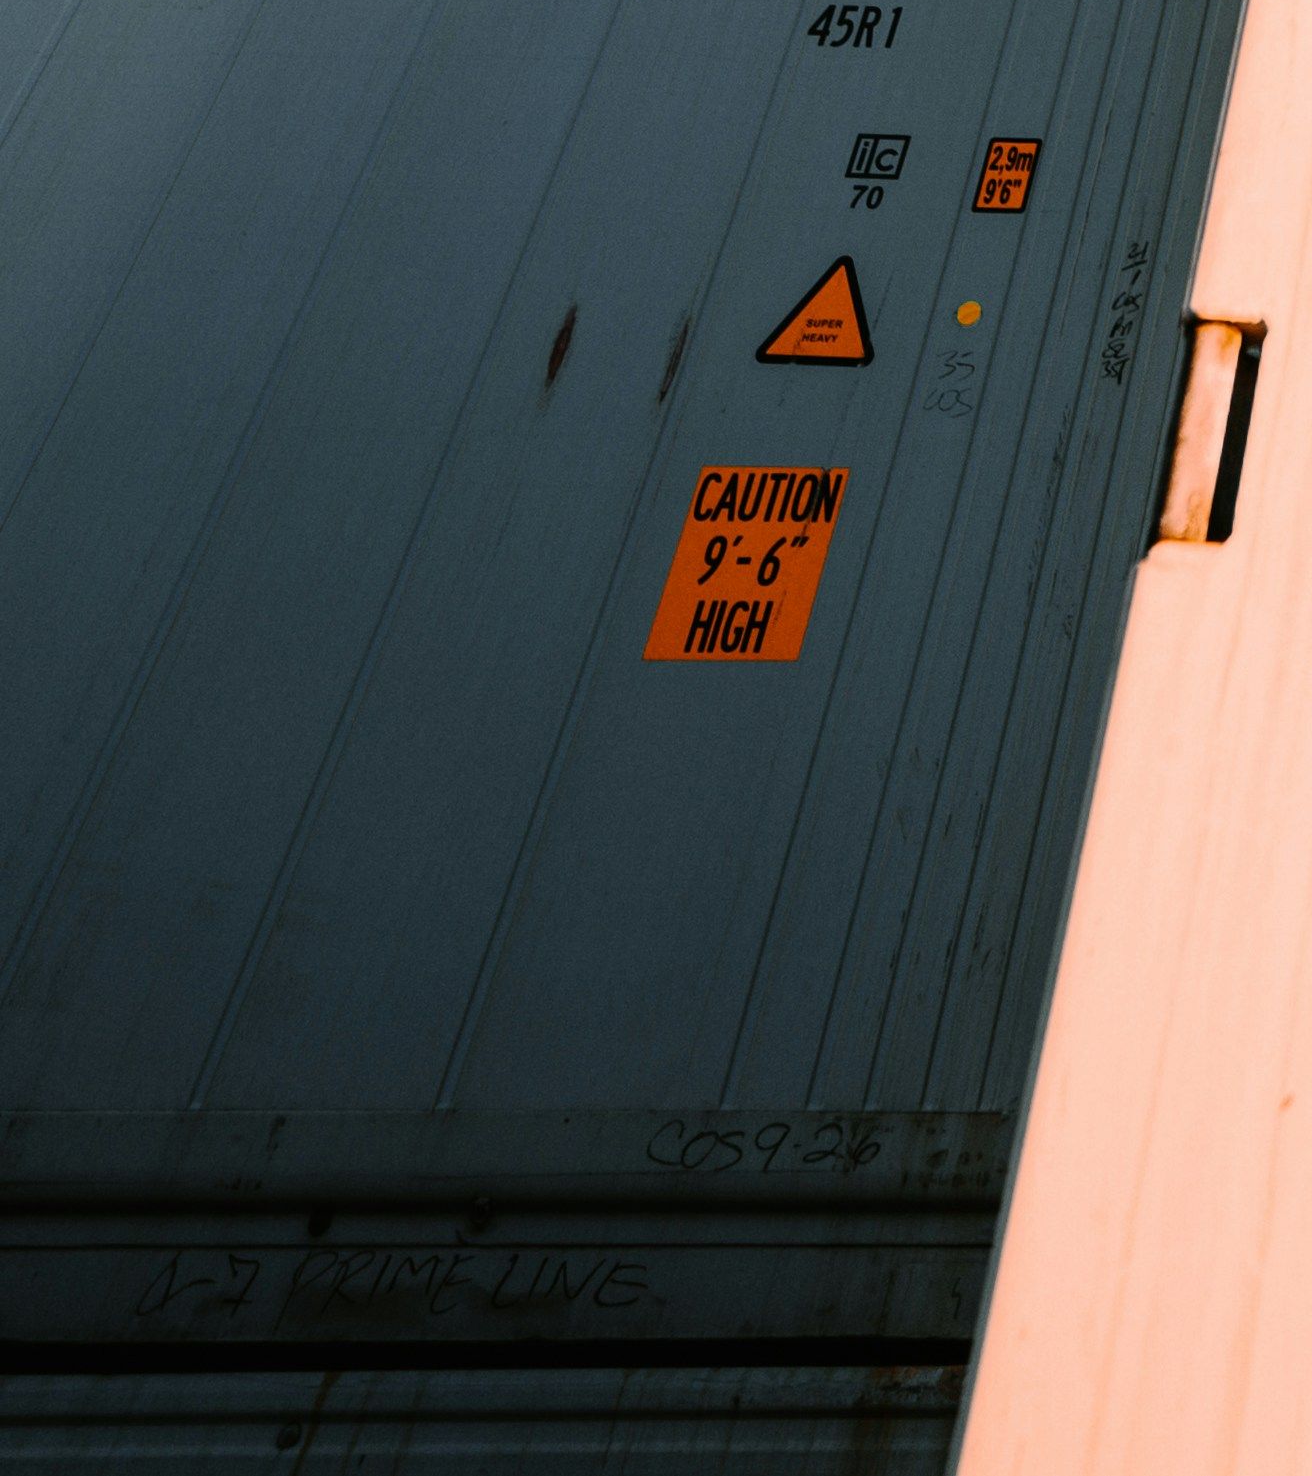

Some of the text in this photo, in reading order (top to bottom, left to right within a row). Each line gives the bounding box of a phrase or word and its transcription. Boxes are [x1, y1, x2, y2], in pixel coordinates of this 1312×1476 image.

[807, 4, 904, 48] 45R1
[849, 185, 884, 209] 70
[802, 332, 838, 343] HEAVY
[806, 319, 843, 329] SUPER
[693, 472, 843, 523] CAUTION
[683, 600, 773, 654] HIGH
[491, 1253, 650, 1308] LINE
